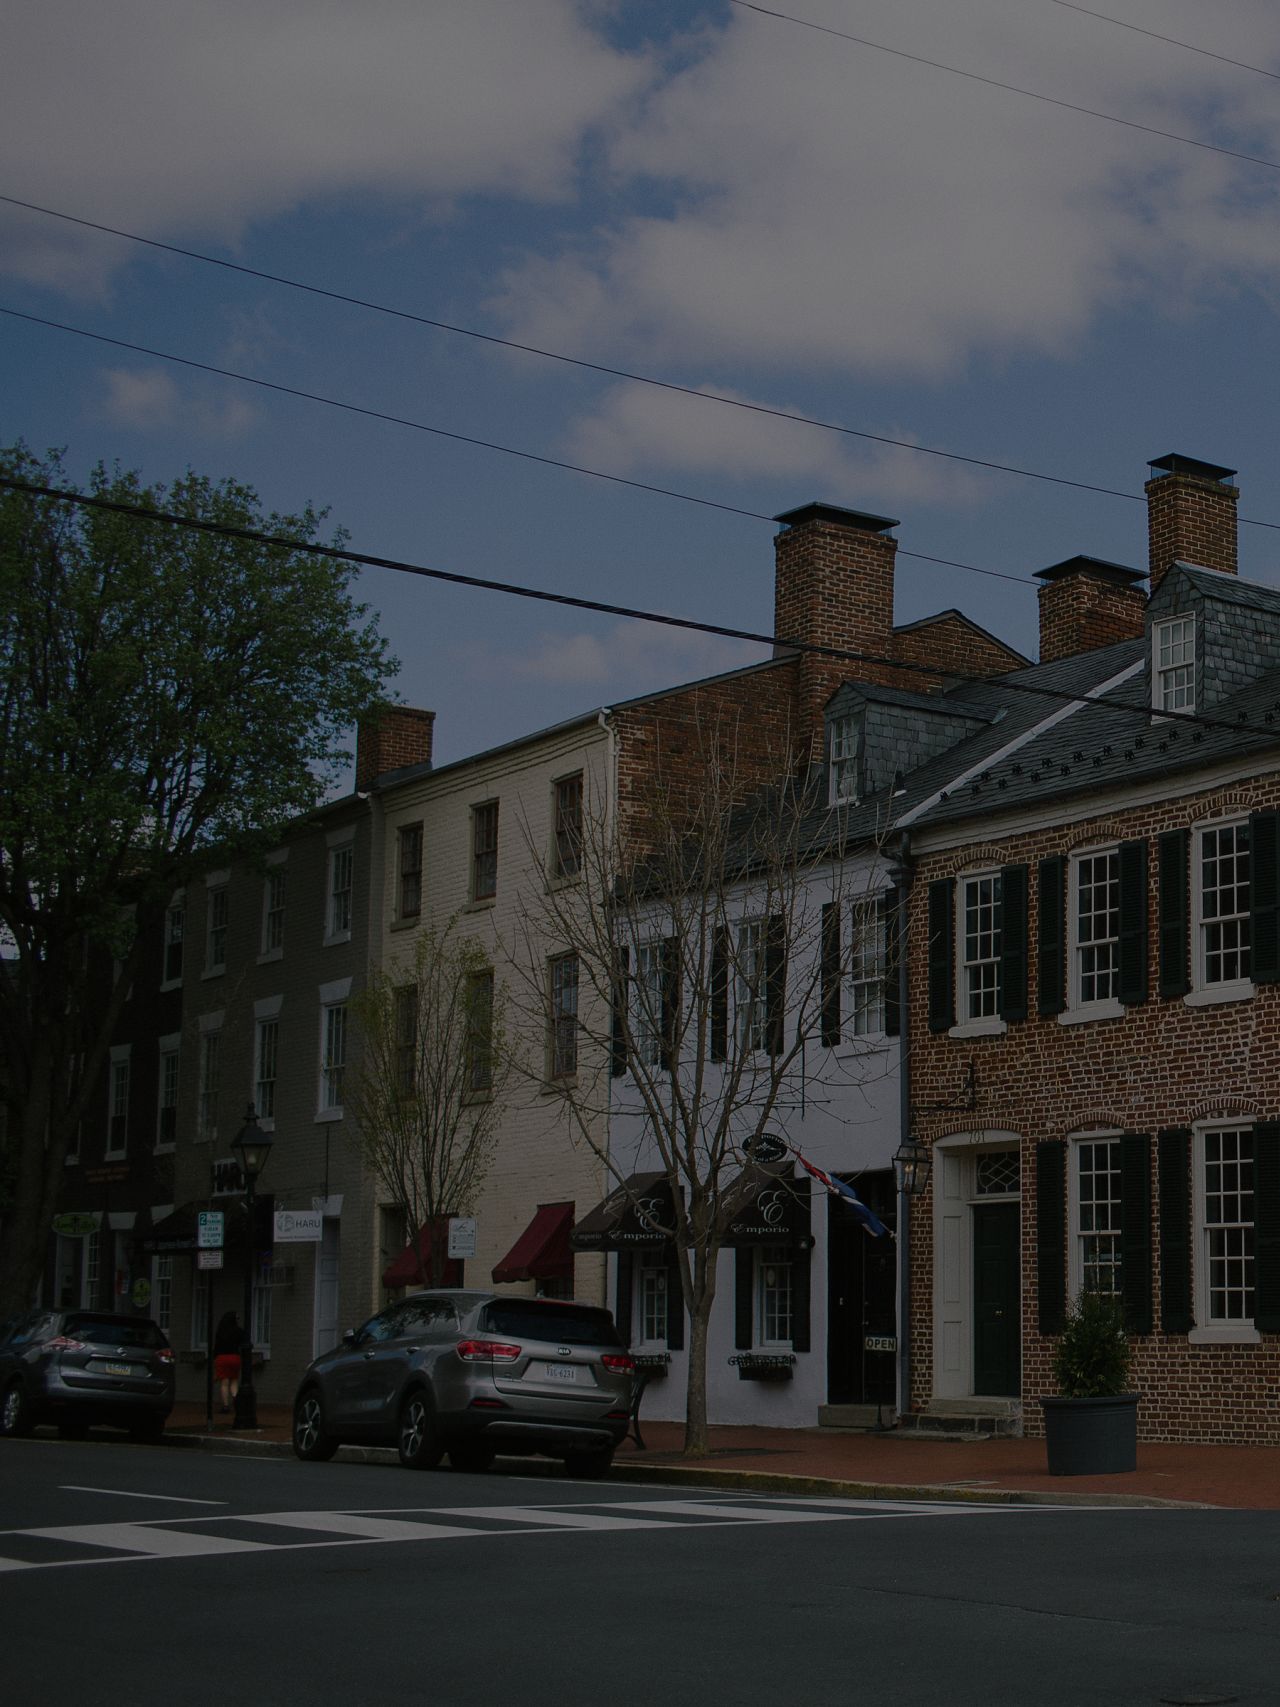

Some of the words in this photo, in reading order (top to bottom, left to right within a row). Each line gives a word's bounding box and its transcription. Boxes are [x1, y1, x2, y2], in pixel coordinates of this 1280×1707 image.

[968, 1130, 985, 1143] 701
[295, 1219, 320, 1228] HARU
[730, 1223, 789, 1234] Emporio
[608, 1230, 666, 1240] Emporio
[866, 1338, 896, 1350] OPEN
